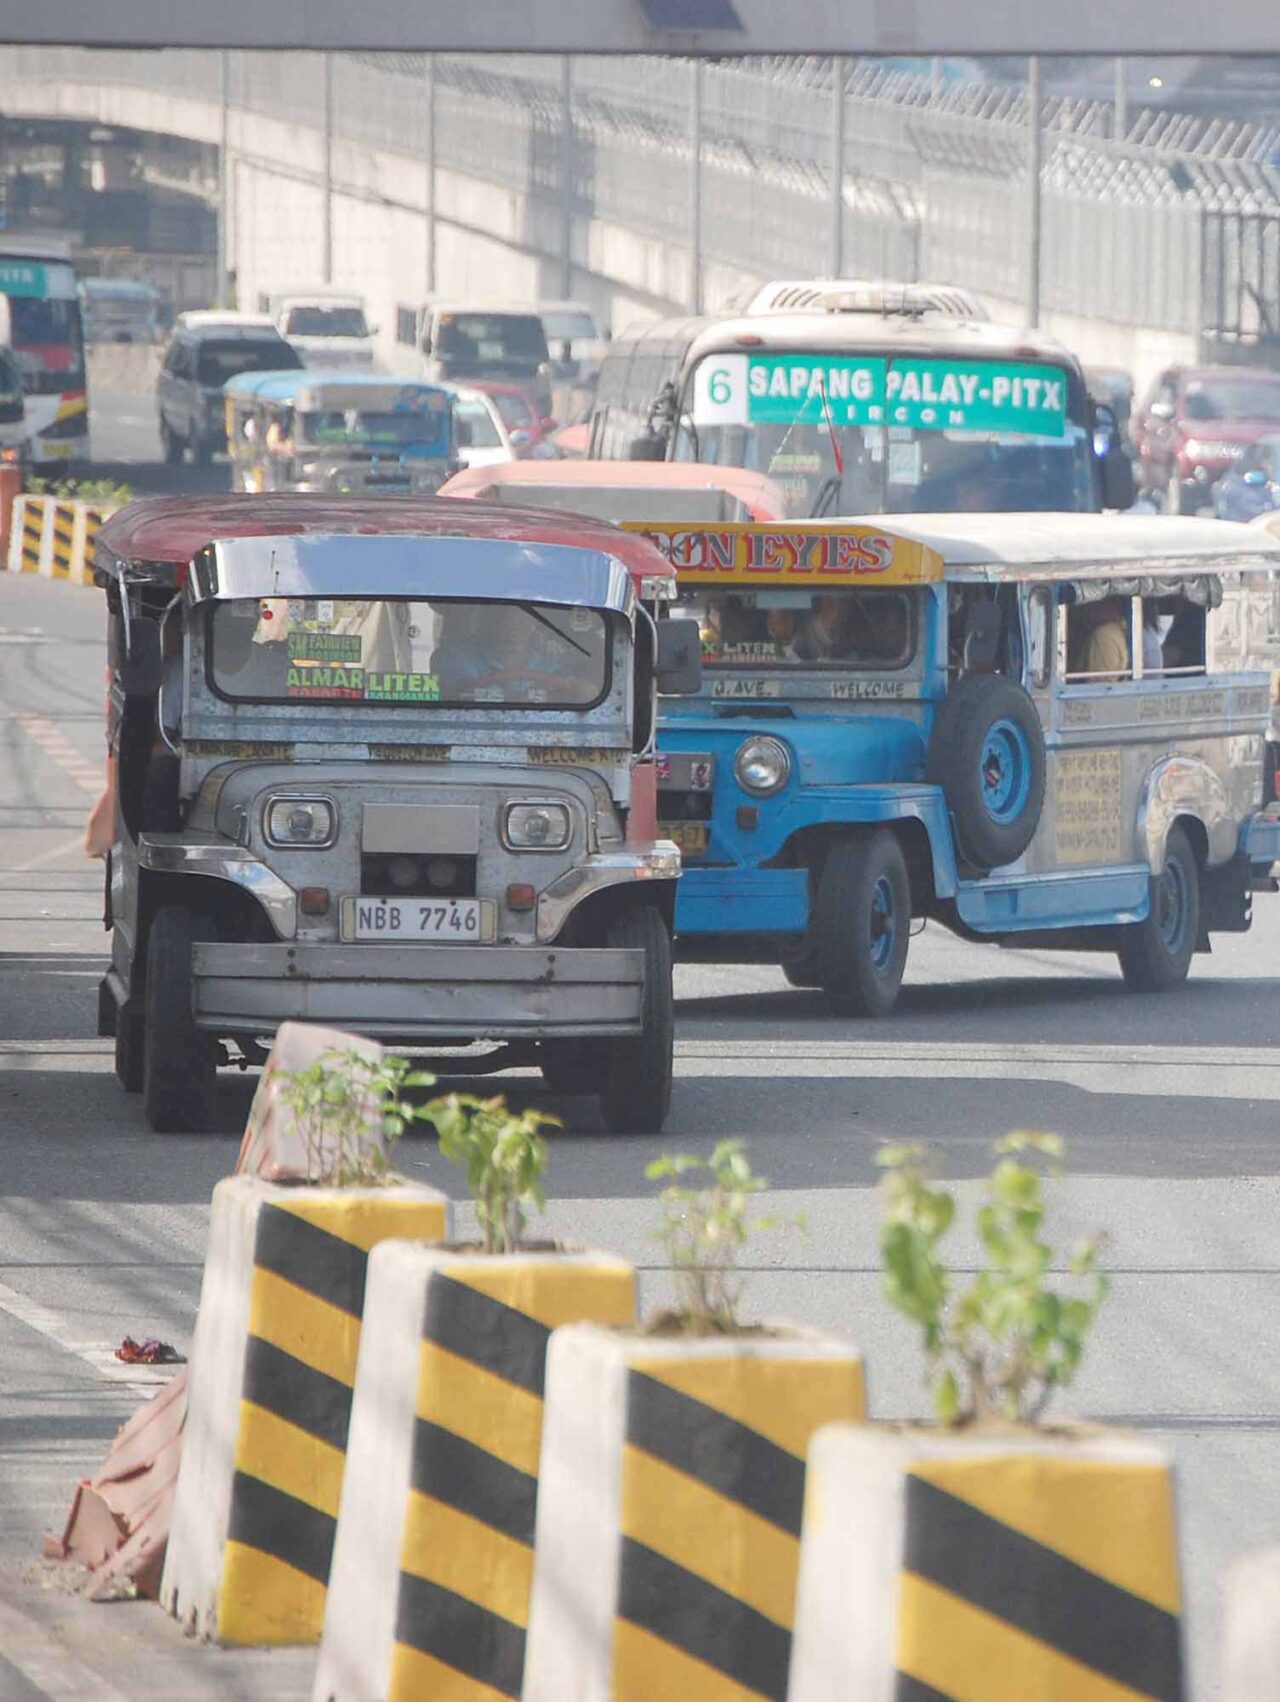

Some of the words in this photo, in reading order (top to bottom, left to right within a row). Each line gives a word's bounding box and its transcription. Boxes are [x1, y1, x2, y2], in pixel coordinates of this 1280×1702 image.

[708, 369, 732, 404] 6
[748, 366, 873, 400] SAPANG
[885, 370, 1063, 411] PALAY-PITX
[744, 532, 896, 574] EYES
[286, 668, 364, 688] ALMAR
[369, 674, 440, 691] LITEX
[832, 681, 905, 698] WELCOME
[359, 906, 401, 931] NBB
[419, 907, 477, 932] 7746
